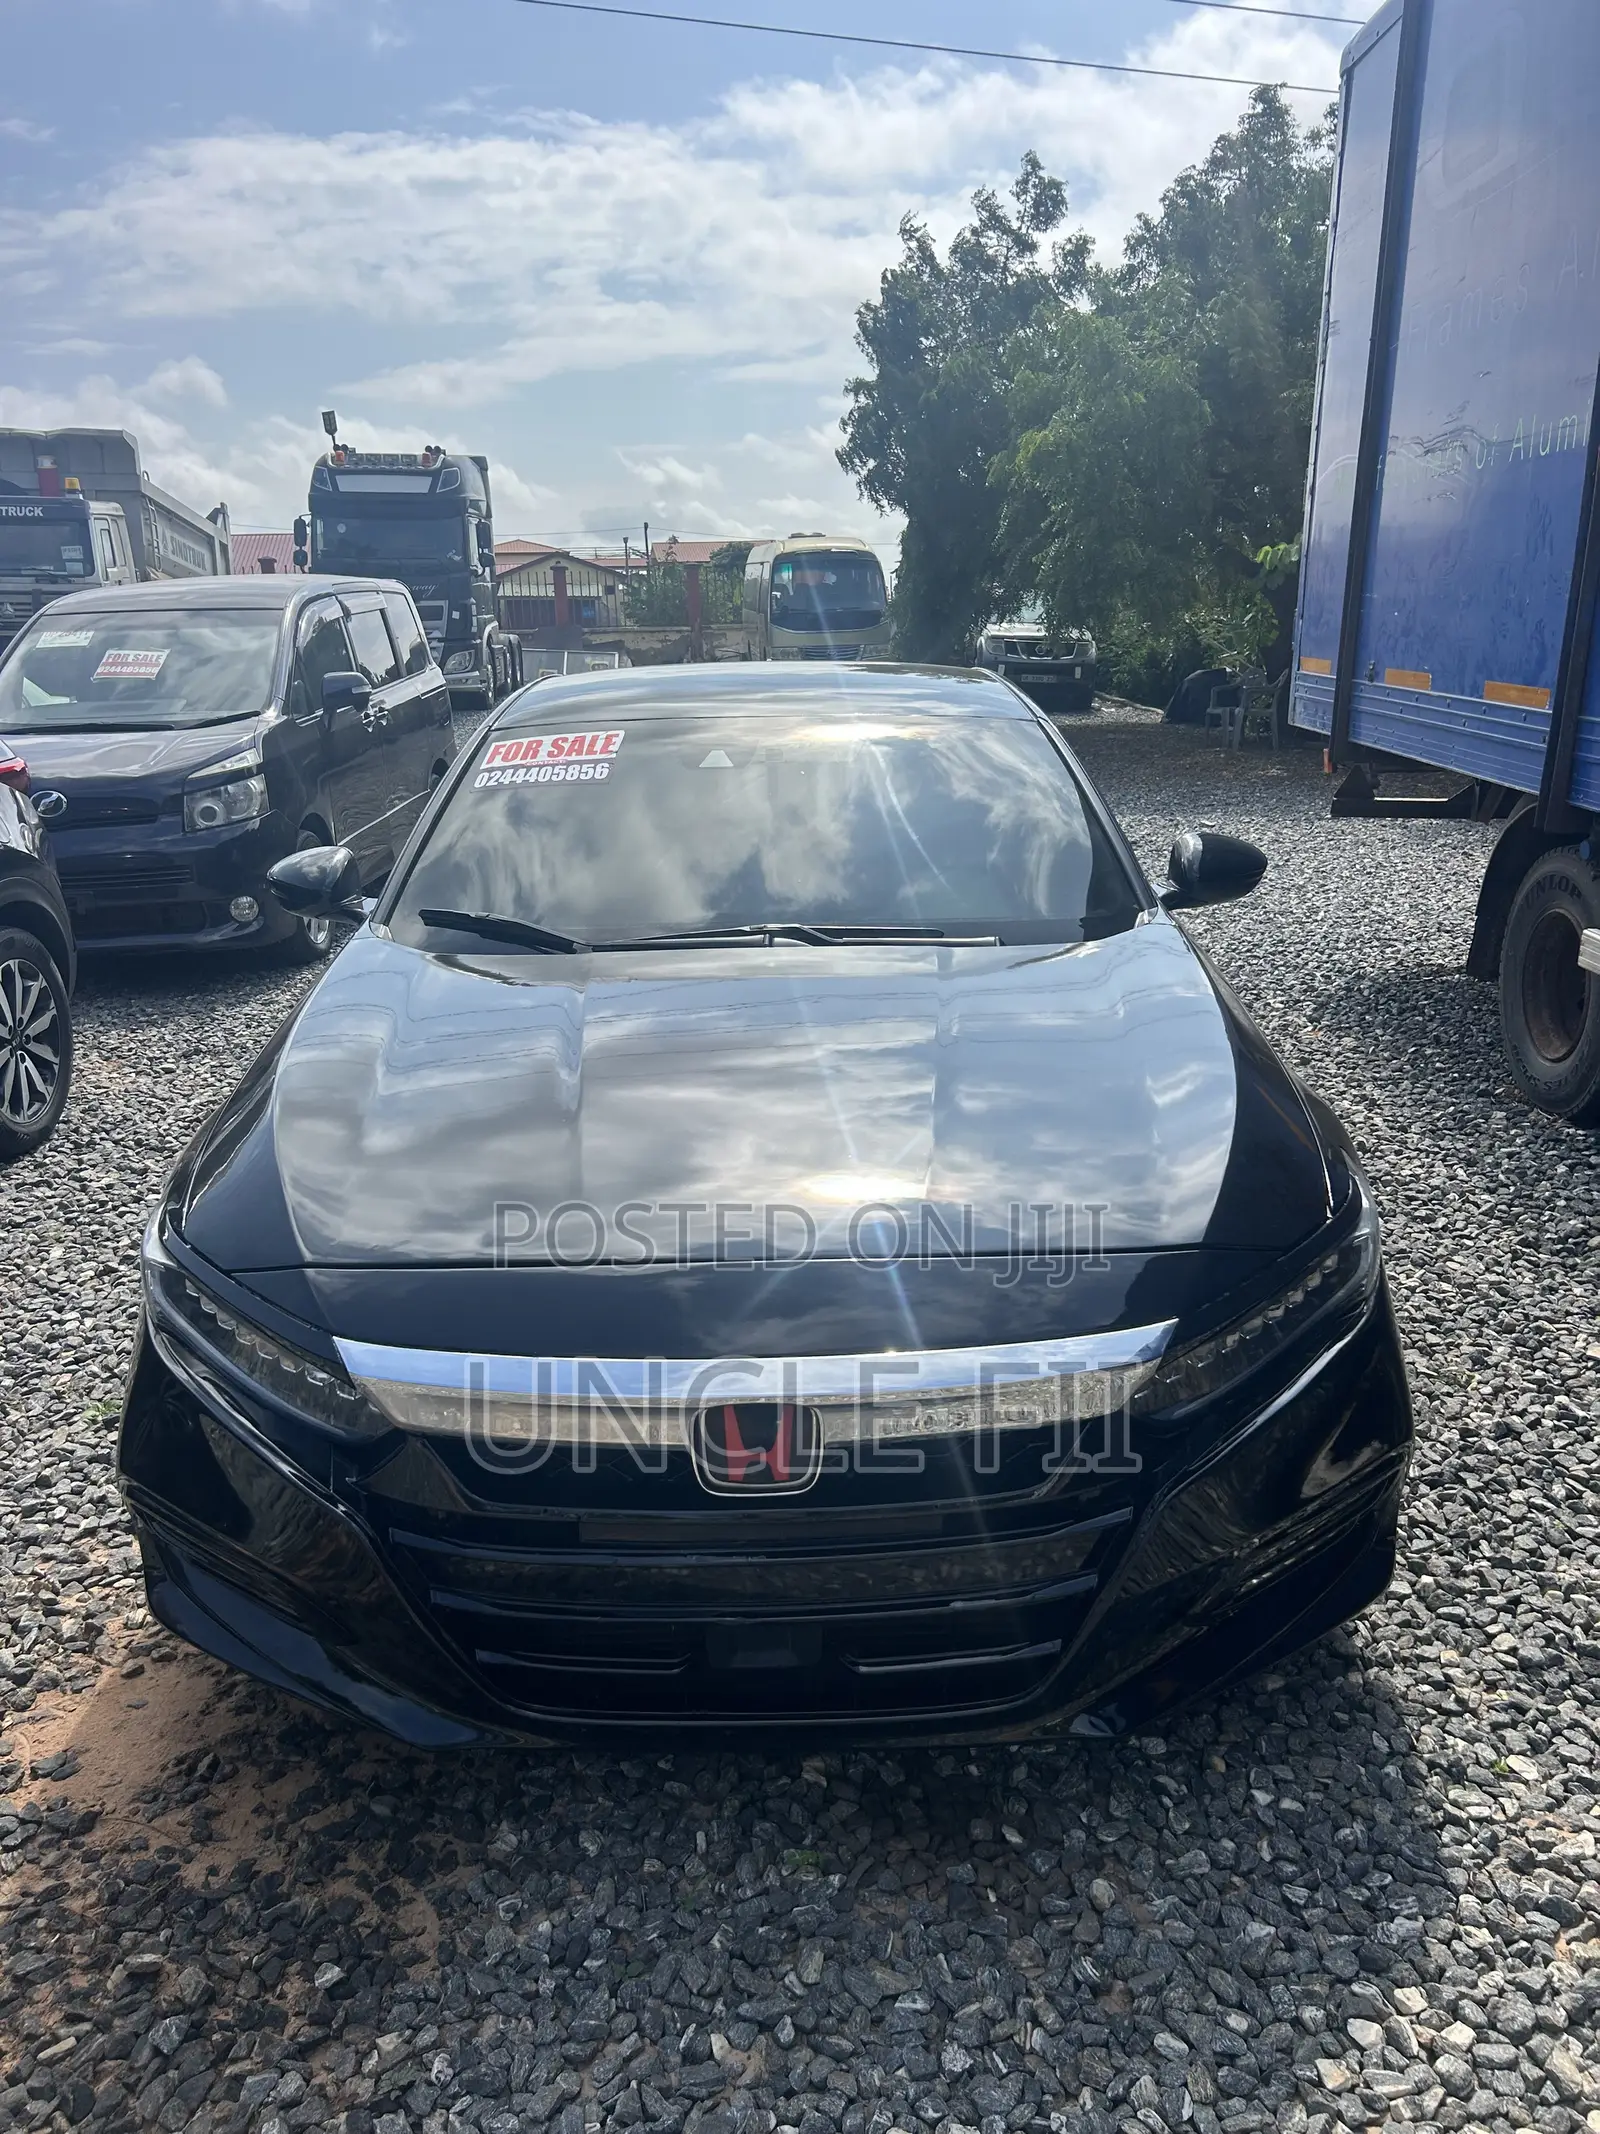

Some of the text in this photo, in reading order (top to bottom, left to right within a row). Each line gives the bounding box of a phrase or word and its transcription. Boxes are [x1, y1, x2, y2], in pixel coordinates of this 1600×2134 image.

[106, 653, 164, 663] FOR SALE
[485, 733, 620, 765] FOR SALE
[474, 762, 611, 788] 0244405856
[1519, 873, 1584, 913] UNLOP
